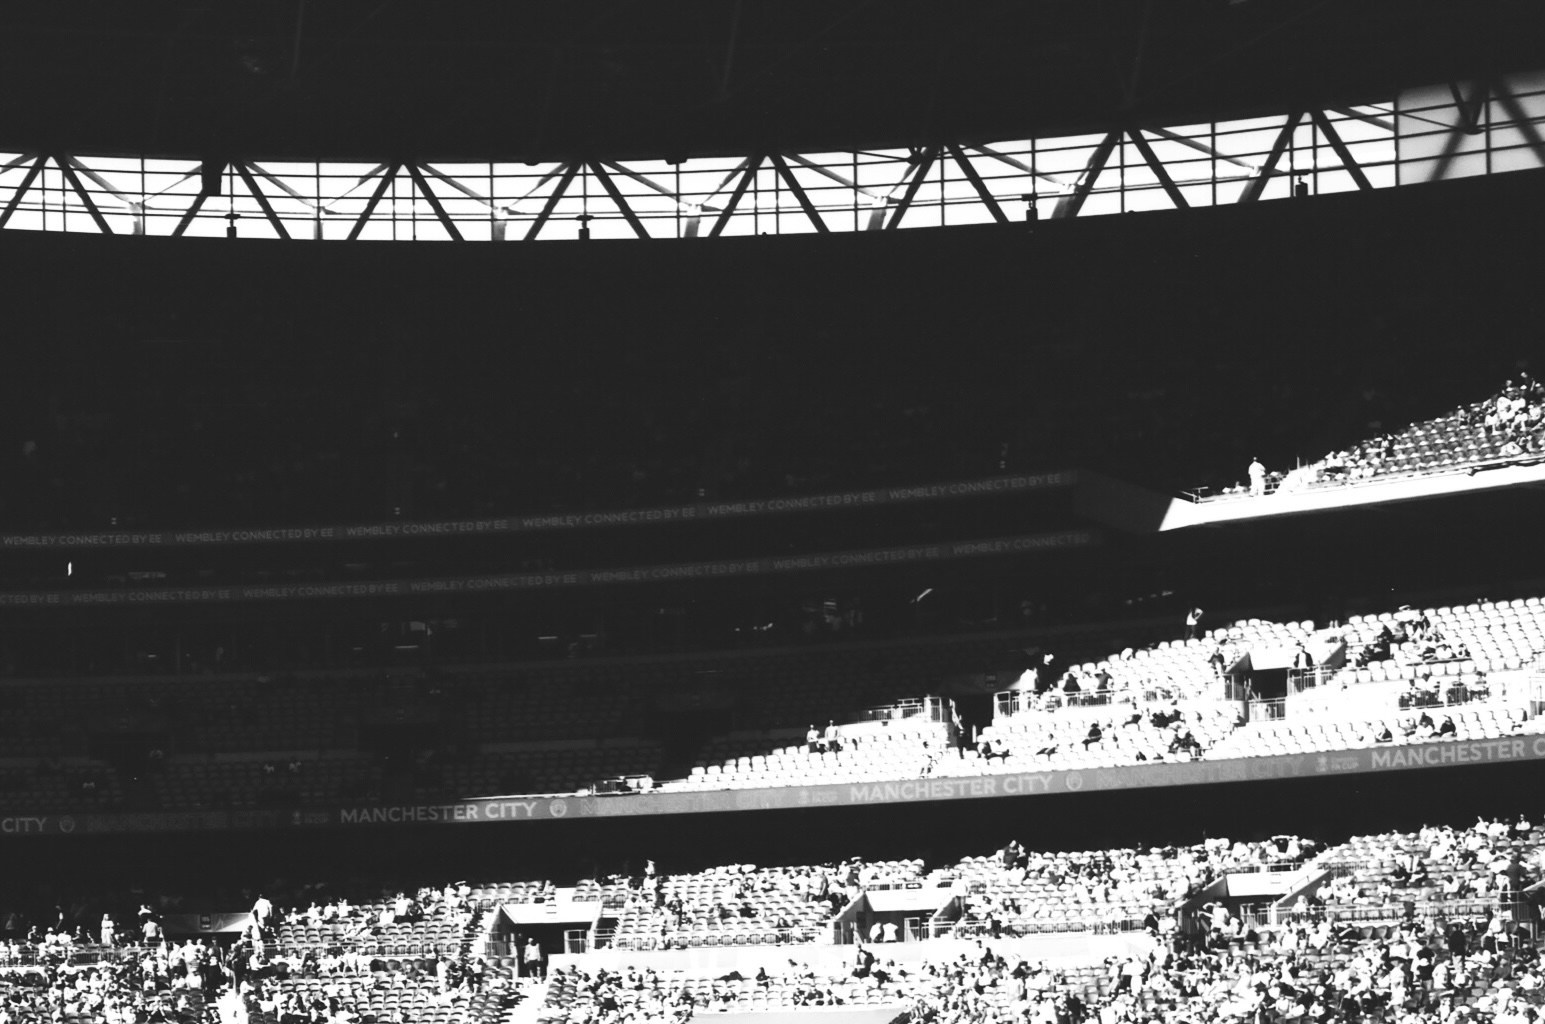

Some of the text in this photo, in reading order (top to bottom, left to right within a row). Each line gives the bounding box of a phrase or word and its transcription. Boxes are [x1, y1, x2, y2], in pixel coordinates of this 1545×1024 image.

[889, 474, 1061, 500] WEMBLEY CONNECTED BY EE
[707, 491, 876, 516] WEMBLEY CONNECTED BY EE
[523, 507, 696, 528] WEMBLEY CONNECTED BY EE
[175, 528, 334, 543] WEMBLEY CONNECTED BY EE
[346, 520, 507, 536] WEMBLEY CONNECTED BY EE
[3, 534, 162, 546] WEMBLEY CONNECTED BY EE
[952, 534, 1089, 555] WEMBLEY CONNECTED
[773, 547, 939, 570] WEMBLEY CONNECTED BY EE
[591, 562, 760, 582] WEMBLEY CONNECTED BY EE
[243, 583, 398, 598] WEMBLEY CONNECTED BY EE
[410, 574, 577, 592] WEMBLEY CONNECTED BY EE
[30, 594, 44, 603] BY
[47, 594, 59, 603] EE
[72, 589, 231, 603] WEMBLEY CONNECTED BY EE
[1371, 741, 1525, 769] MANCHESTER
[850, 777, 996, 803] MANCHESTER
[1003, 774, 1054, 794] CITY
[340, 804, 478, 824] MANCHESTER
[485, 801, 537, 818] CITY
[1, 817, 48, 833] CITY
